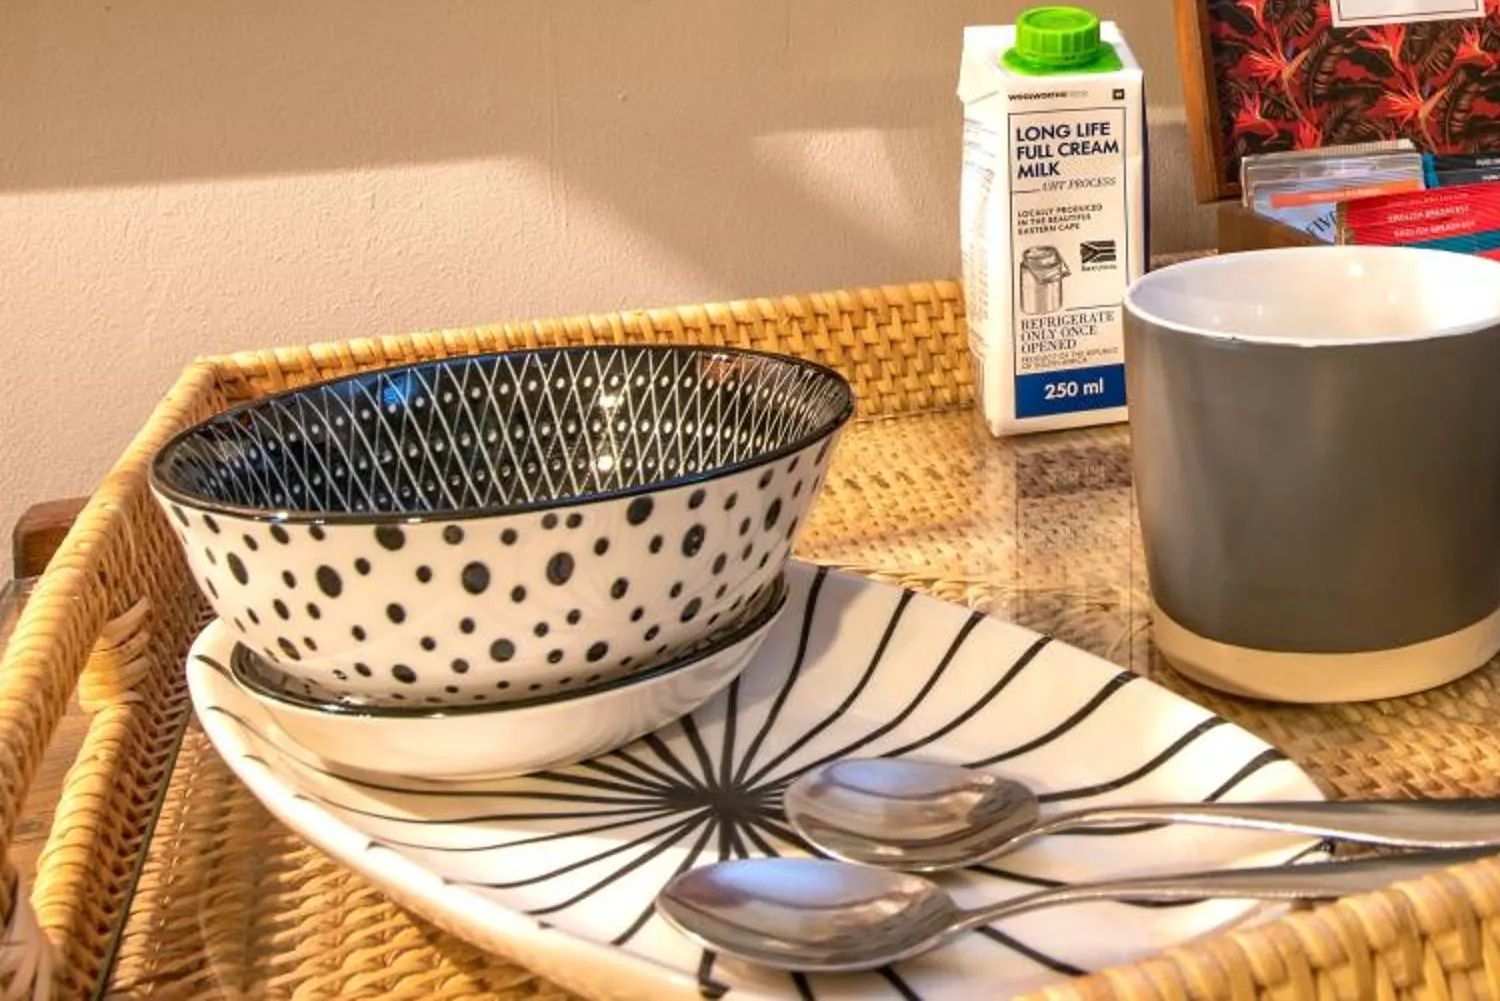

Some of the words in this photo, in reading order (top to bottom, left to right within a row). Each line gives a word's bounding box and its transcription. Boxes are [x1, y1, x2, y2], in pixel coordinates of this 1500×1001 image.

[1016, 124, 1071, 142] LONG
[1077, 121, 1111, 138] LIFE
[1017, 143, 1054, 161] FULL
[1057, 138, 1120, 157] CREAM
[1017, 161, 1061, 180] MILK
[1067, 177, 1117, 190] PROCESS
[1017, 208, 1054, 218] LOCALLY
[1056, 203, 1103, 214] PRODUCED
[1017, 225, 1057, 236] EASTERN
[1058, 222, 1080, 232] CAPE
[1030, 217, 1046, 226] THE
[1020, 310, 1115, 331] REFRIGERATE
[1020, 328, 1057, 342] ONLY
[1060, 324, 1098, 337] ONCE
[1020, 338, 1078, 354] OPENED
[1043, 380, 1079, 400] 250
[1083, 377, 1104, 396] ml
